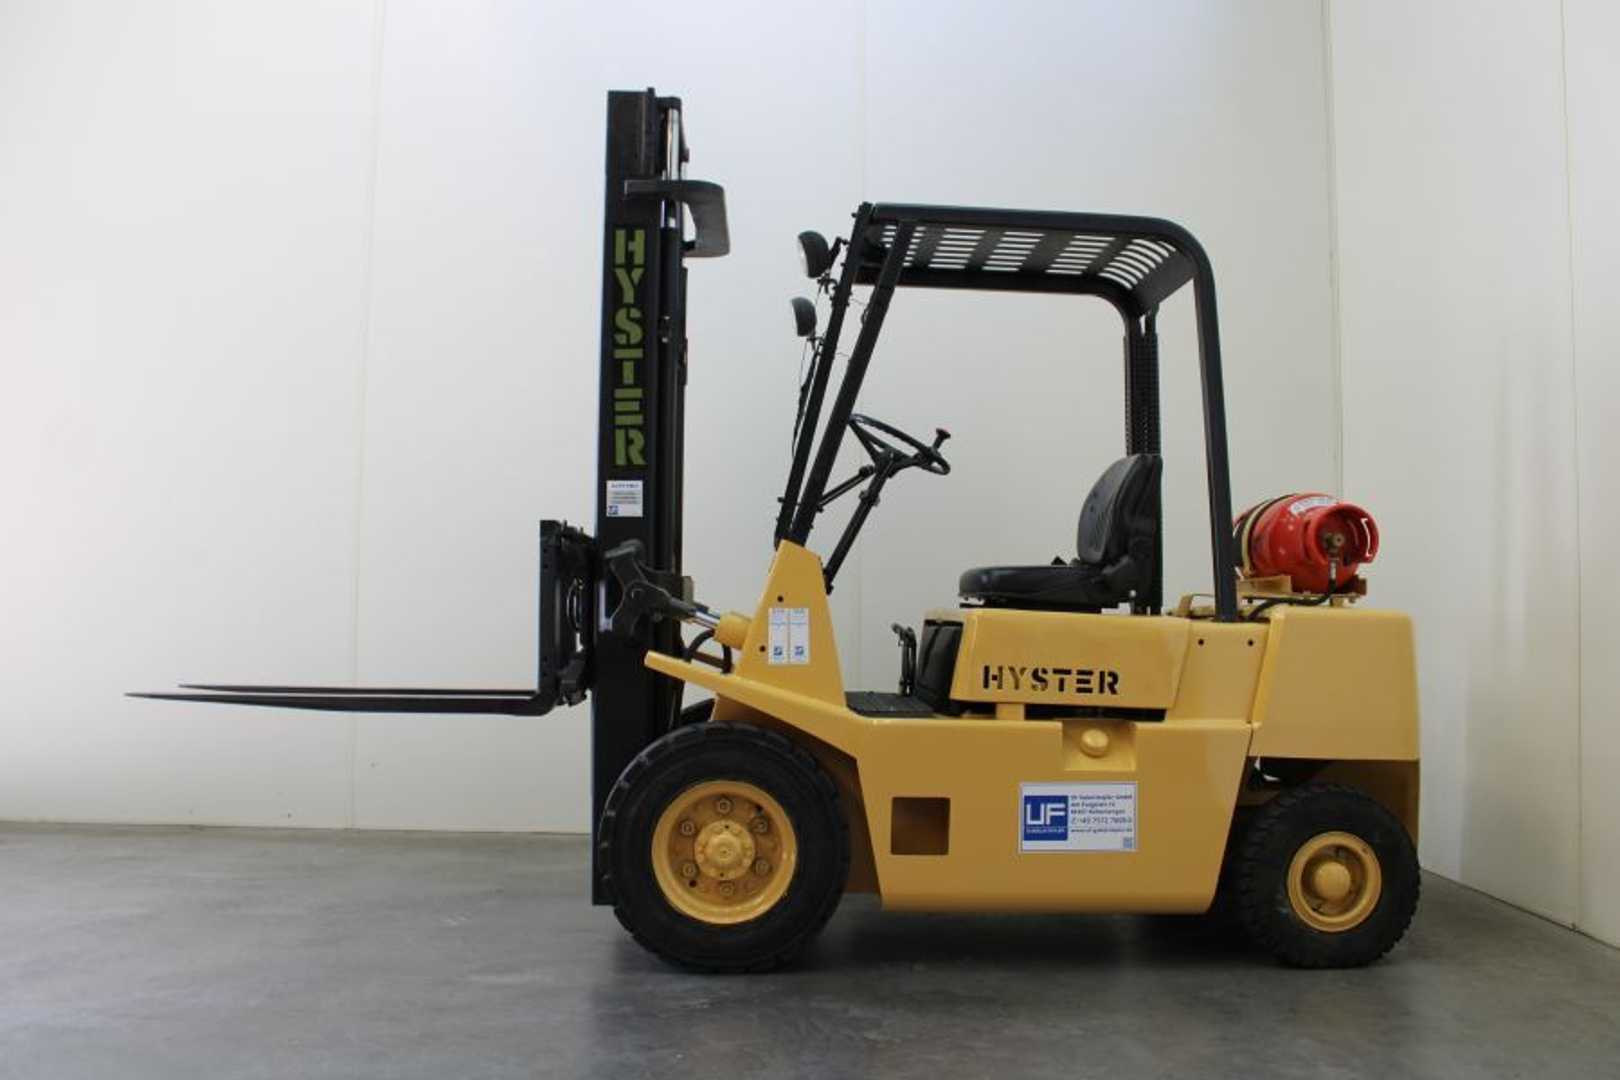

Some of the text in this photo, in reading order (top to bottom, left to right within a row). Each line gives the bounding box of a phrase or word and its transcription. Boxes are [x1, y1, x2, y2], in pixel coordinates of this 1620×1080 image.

[614, 229, 646, 466] HYSTER
[983, 665, 1119, 695] HYSTER
[1026, 803, 1066, 825] UF
